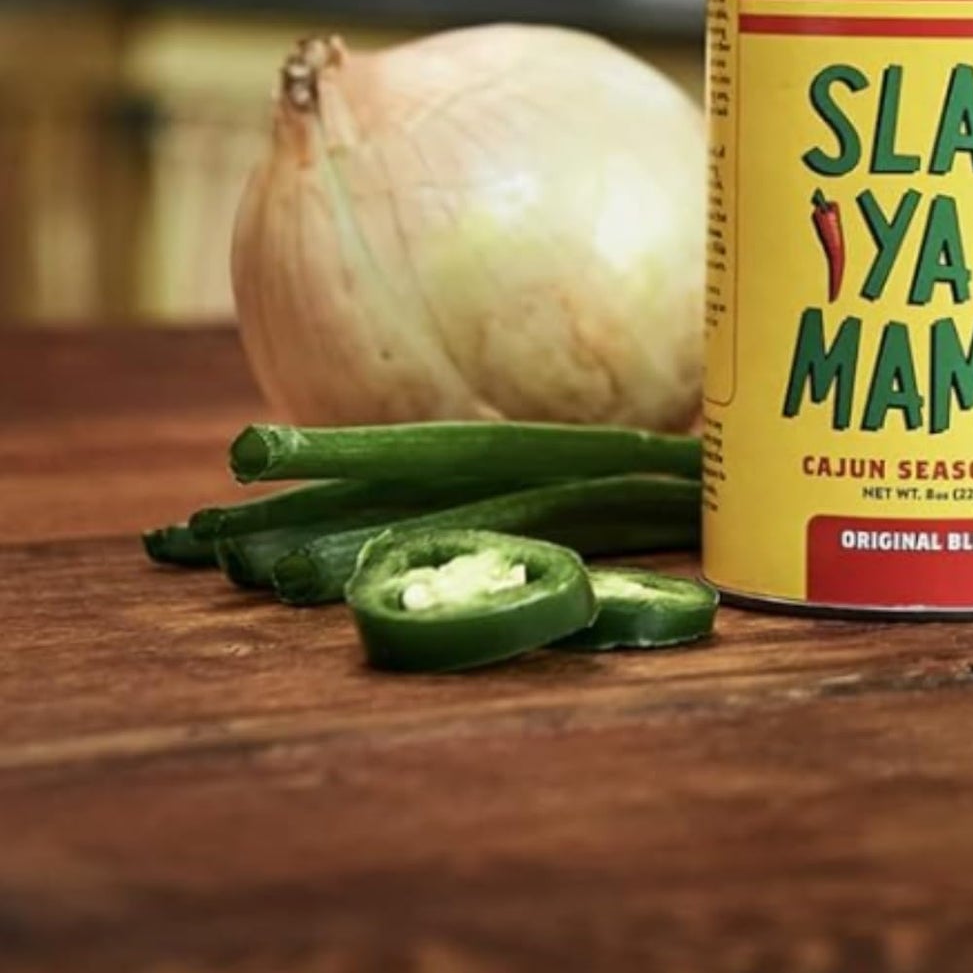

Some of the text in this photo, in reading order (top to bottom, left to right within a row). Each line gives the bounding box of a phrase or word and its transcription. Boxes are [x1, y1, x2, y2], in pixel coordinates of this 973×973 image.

[856, 188, 972, 306] YA
[802, 455, 886, 479] CAJUN
[862, 487, 892, 500] NET
[896, 487, 921, 500] WT.
[841, 530, 942, 551] ORIGINAL
